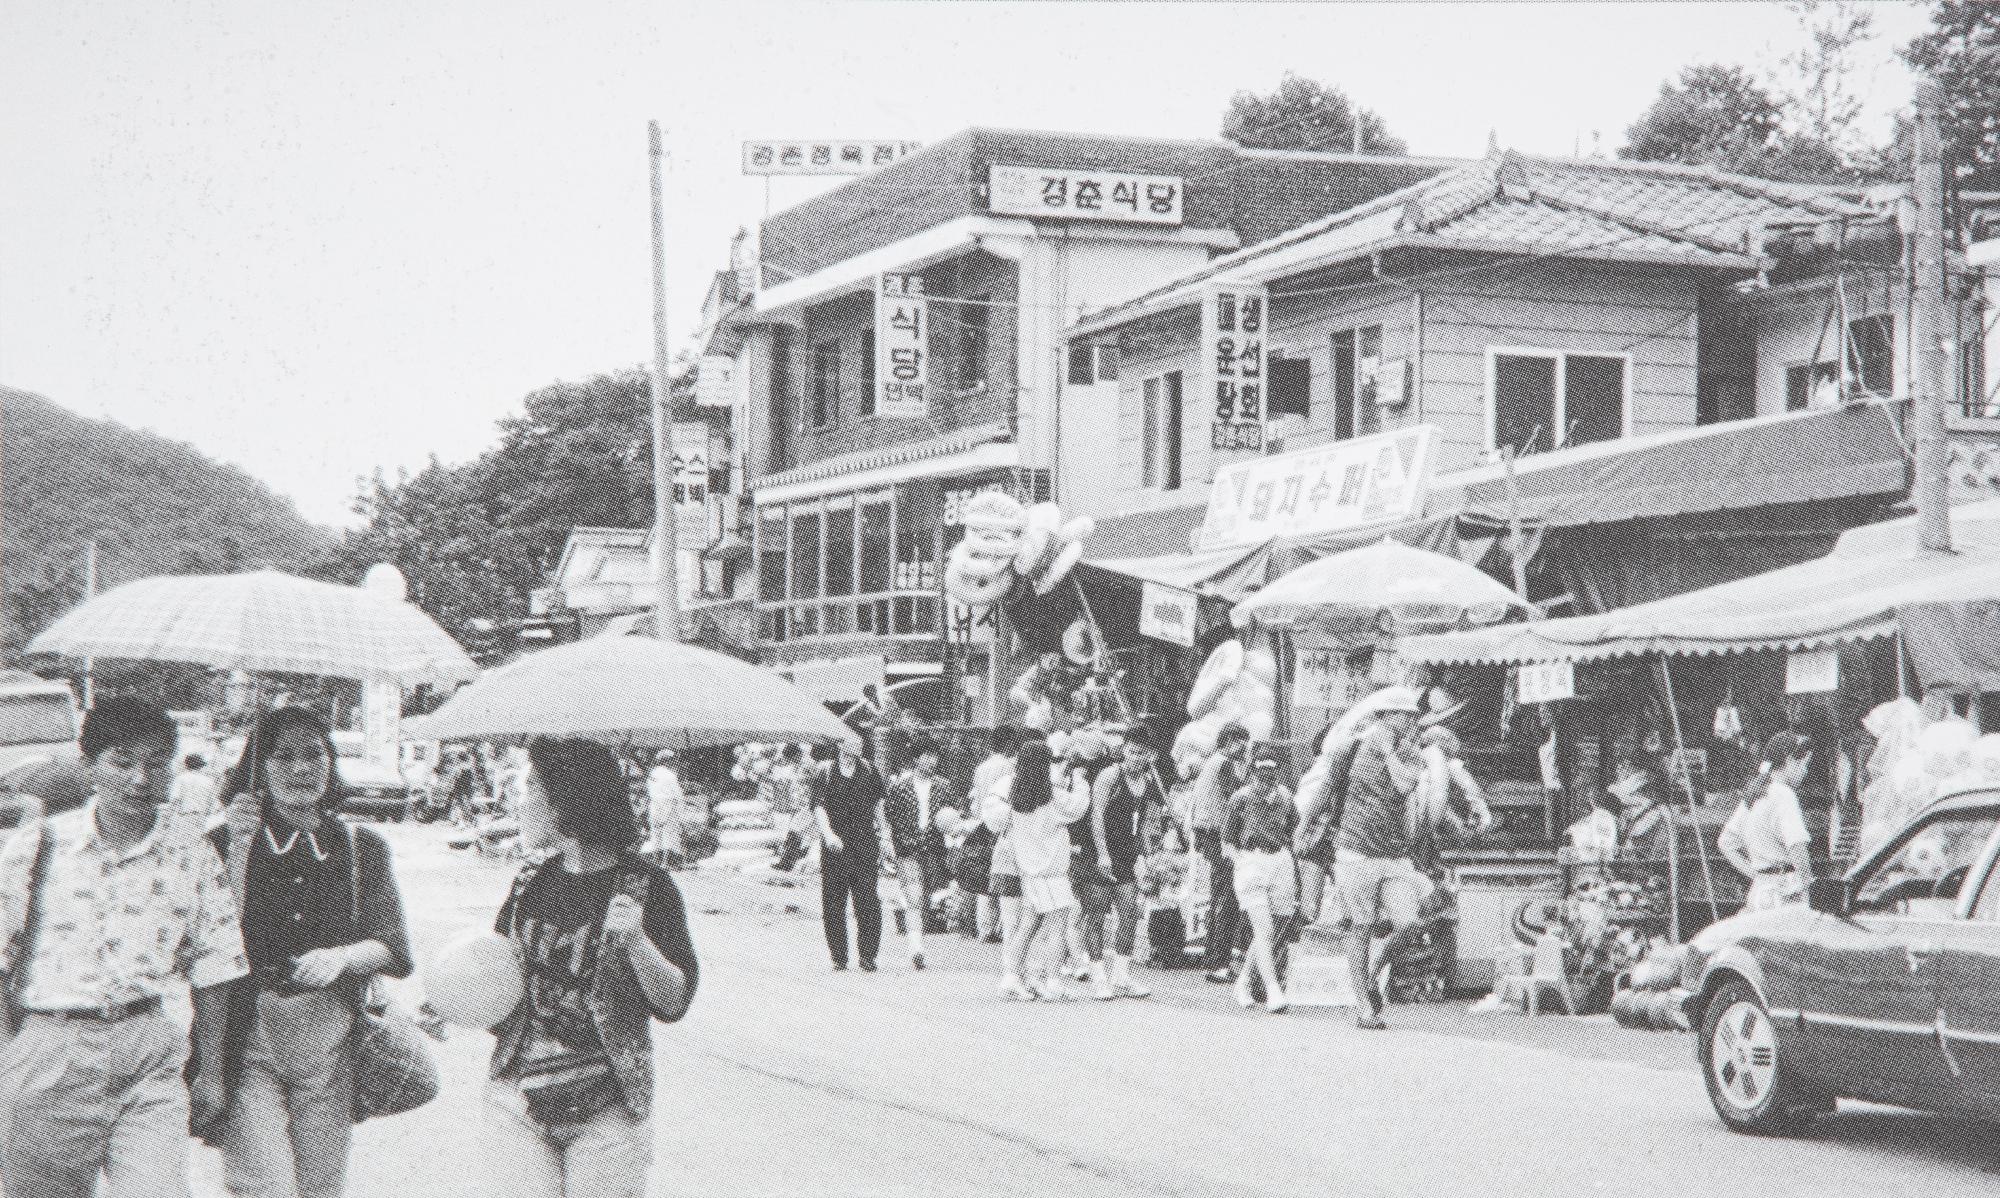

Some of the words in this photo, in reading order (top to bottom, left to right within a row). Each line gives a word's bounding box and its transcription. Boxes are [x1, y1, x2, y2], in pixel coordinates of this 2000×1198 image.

[1041, 176, 1176, 214] 경춘식당
[890, 305, 923, 379] 식당
[1240, 295, 1260, 421] 생선회
